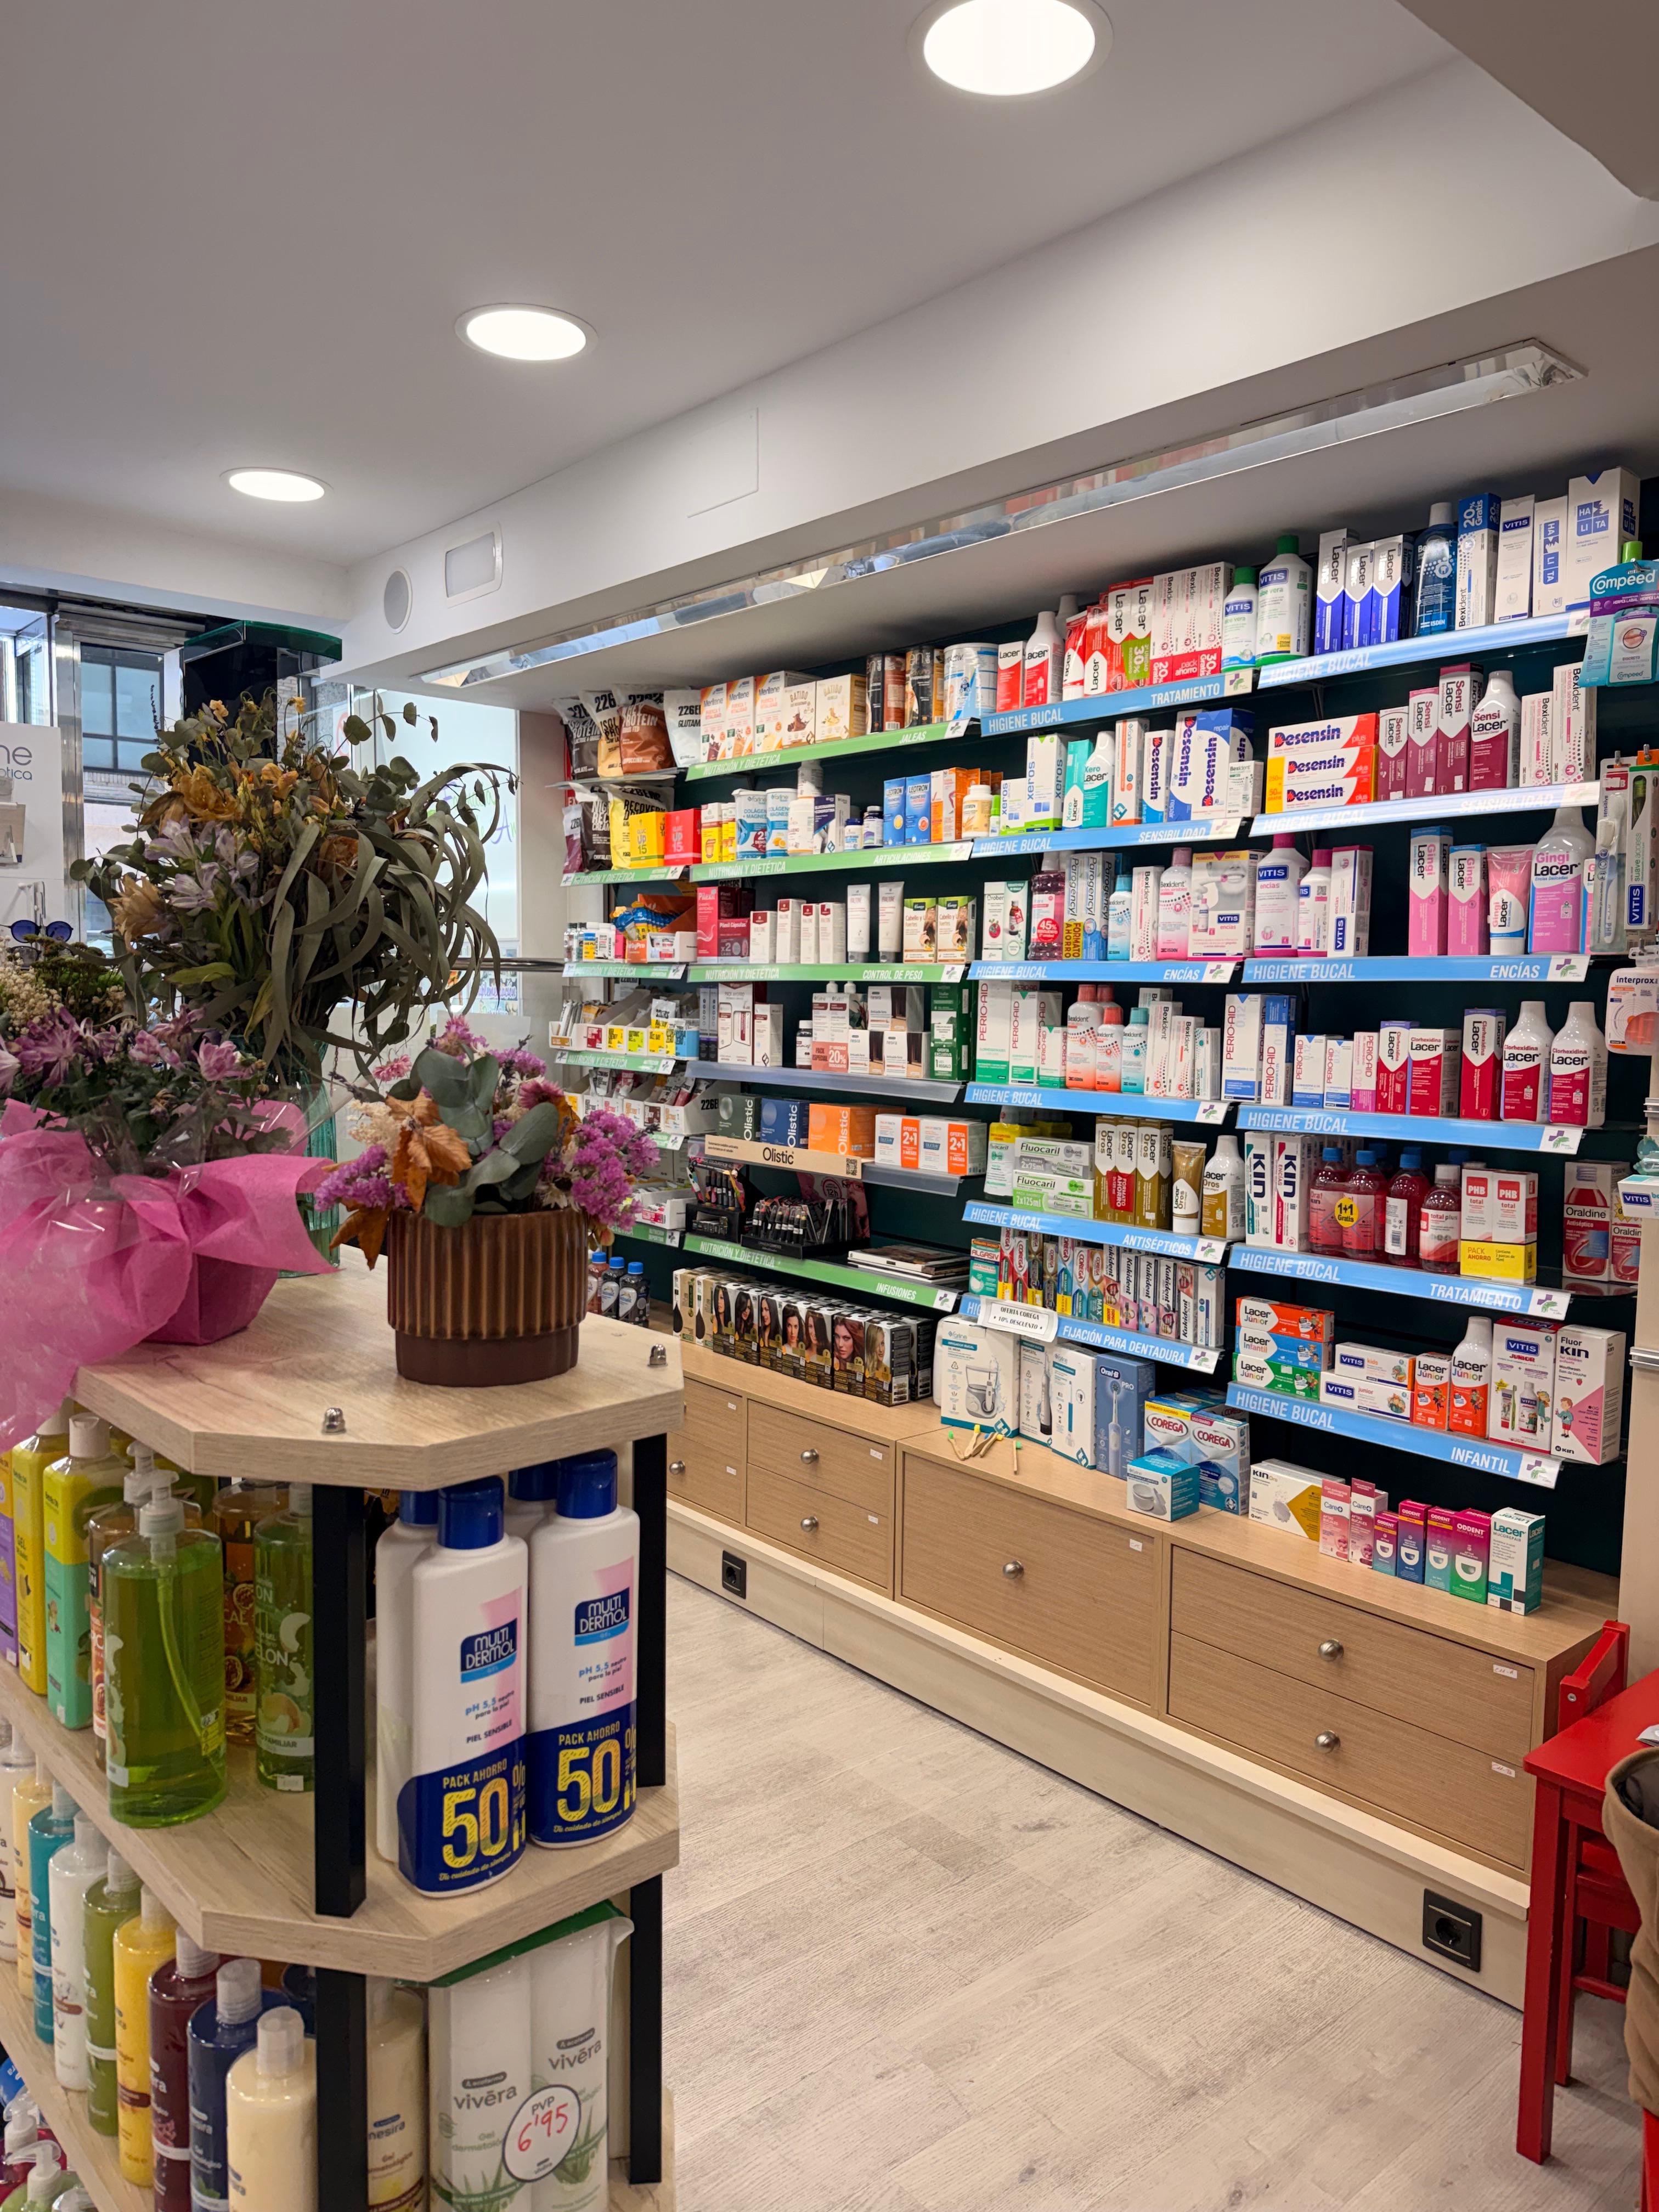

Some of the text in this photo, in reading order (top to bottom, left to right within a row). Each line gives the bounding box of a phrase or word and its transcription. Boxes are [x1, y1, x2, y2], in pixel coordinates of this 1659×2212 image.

[1464, 502, 1475, 528] 20%
[1505, 519, 1528, 529] VITIS
[1592, 571, 1655, 595] Compeed
[1458, 588, 1466, 627] Bexident
[999, 649, 1020, 659] Lacer
[1175, 667, 1198, 676] ahorro
[1181, 659, 1197, 668] pack
[989, 685, 1220, 732] HIGIENE BUCAL TRATAMIENTO
[1474, 710, 1500, 722] Sensi
[1472, 720, 1506, 732] Lacer
[1274, 725, 1341, 747] Desensin
[703, 731, 927, 776] NUTRICIÓN Y DIETÉTICA JALEAS
[1288, 755, 1345, 774] Desensin
[909, 784, 929, 794] LEOTRON
[980, 827, 1206, 854] HIGIENE BUCAL SENSIBILIDAD
[708, 852, 932, 878] NUTRICIÓN Y DIETÉTICA ARTICULACIONES
[1536, 852, 1570, 865] Gingi
[1259, 868, 1285, 877] VITIS
[1534, 862, 1578, 876] Lacer
[1086, 856, 1097, 917] Parogencyl
[1632, 888, 1640, 922] VITIS
[1039, 920, 1057, 930] 45%
[705, 968, 923, 980] NUTRICIÓN Y DIETÉTICA CONTROL DE PESO
[976, 966, 1200, 980] HIGIENE BUCAL ENCÍAS
[1253, 962, 1541, 980] HIGIENE BUCAL ENCÍAS
[1616, 976, 1655, 984] interprox
[1410, 1042, 1440, 1052] Lacer
[1504, 1051, 1540, 1062] Lacer
[1551, 1054, 1589, 1066] Lacer
[972, 1090, 1042, 1105] HIGIENE BUCAL
[787, 1104, 798, 1148] Olistic
[1248, 1112, 1349, 1133] HIGIENE BUCAL
[838, 1110, 849, 1155] Olistic
[902, 1132, 917, 1146] 2+1
[763, 1147, 794, 1165] Olistic
[1021, 1142, 1060, 1155] Fluocaril
[1017, 1176, 1056, 1189] Fluocaril
[1468, 1185, 1486, 1195] PHB
[1015, 1198, 1041, 1207] 2x125ml
[1624, 1194, 1649, 1204] VITIS
[1337, 1203, 1353, 1216] 1+1
[1566, 1207, 1606, 1218] Oraldine
[970, 1207, 1192, 1257] HIGIENE BUCAL ANTISÉPTICOS
[699, 1241, 917, 1300] NUTRICIÓN Y DIETÉTICA INFUSIONES
[1239, 1252, 1522, 1310] HIGIENE BUCAL TRATAMIENTO
[1000, 1306, 1039, 1320] OFERTA COREGA
[1244, 1306, 1271, 1318] Lacer
[1011, 1319, 1039, 1330] DESCUENTO
[1062, 1325, 1185, 1364] FIJACIÓN PARA DENTADURA
[1243, 1333, 1269, 1346] Lacer
[1509, 1341, 1536, 1353] VITIS
[1561, 1336, 1582, 1346] Fluor
[1240, 1361, 1267, 1374] Lacer
[1341, 1356, 1363, 1365] VITIS
[1418, 1361, 1447, 1373] Lacer
[1453, 1356, 1486, 1372] Lacer
[1100, 1366, 1119, 1379] Oral-B
[1121, 1381, 1135, 1390] PRO
[1152, 1416, 1185, 1433] COREGA
[1236, 1391, 1510, 1474] HIGIENE BUCAL INFANTIL
[1196, 1431, 1231, 1448] COREGA
[1377, 1520, 1394, 1528] ODDENT
[1493, 1521, 1525, 1537] Lacer
[588, 1595, 622, 1618] MULTI
[579, 1607, 627, 1634] DERMOL
[475, 1627, 509, 1652] MULTI
[466, 1641, 515, 1670] DERMOL
[579, 1656, 627, 1678] pH 5,5 neutro
[588, 1665, 622, 1683] para la piel
[579, 1684, 625, 1705] PIEL SENSIBLE
[465, 1690, 515, 1717] pH 5,5 neutro
[475, 1708, 490, 1720] para
[499, 1700, 510, 1710] piel
[466, 1719, 512, 1744] PIEL SENSIBLE
[558, 1720, 620, 1746] PACK AHORRO
[263, 1734, 297, 1748] FAMILIAR
[443, 1758, 507, 1789] PACK AHORRO
[564, 1821, 592, 1833] cuidado
[593, 1818, 601, 1827] de
[602, 1810, 622, 1824] siempre
[451, 1866, 482, 1881] cuidado
[482, 1863, 490, 1872] de
[490, 1853, 511, 1869] siempre
[531, 2096, 555, 2115] PVP
